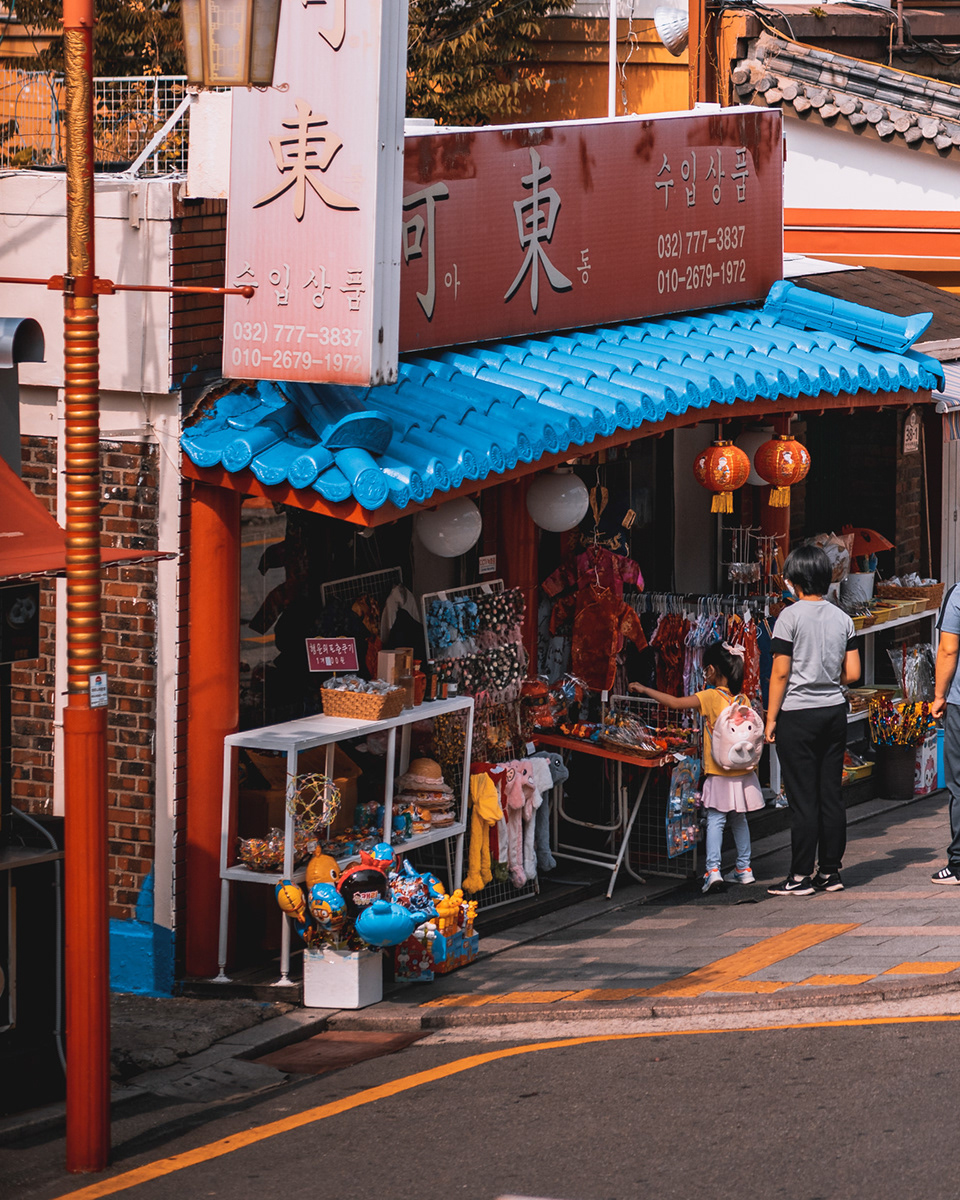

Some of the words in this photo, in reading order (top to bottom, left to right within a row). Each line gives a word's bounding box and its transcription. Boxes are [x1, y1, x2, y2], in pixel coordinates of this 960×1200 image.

[657, 232, 683, 260] 032)
[685, 225, 746, 255] 777-3837
[657, 258, 746, 294] 010-2679-1972
[232, 320, 269, 344] 032)
[273, 323, 363, 349] 777-3837
[231, 346, 363, 375] 010-2679-1972
